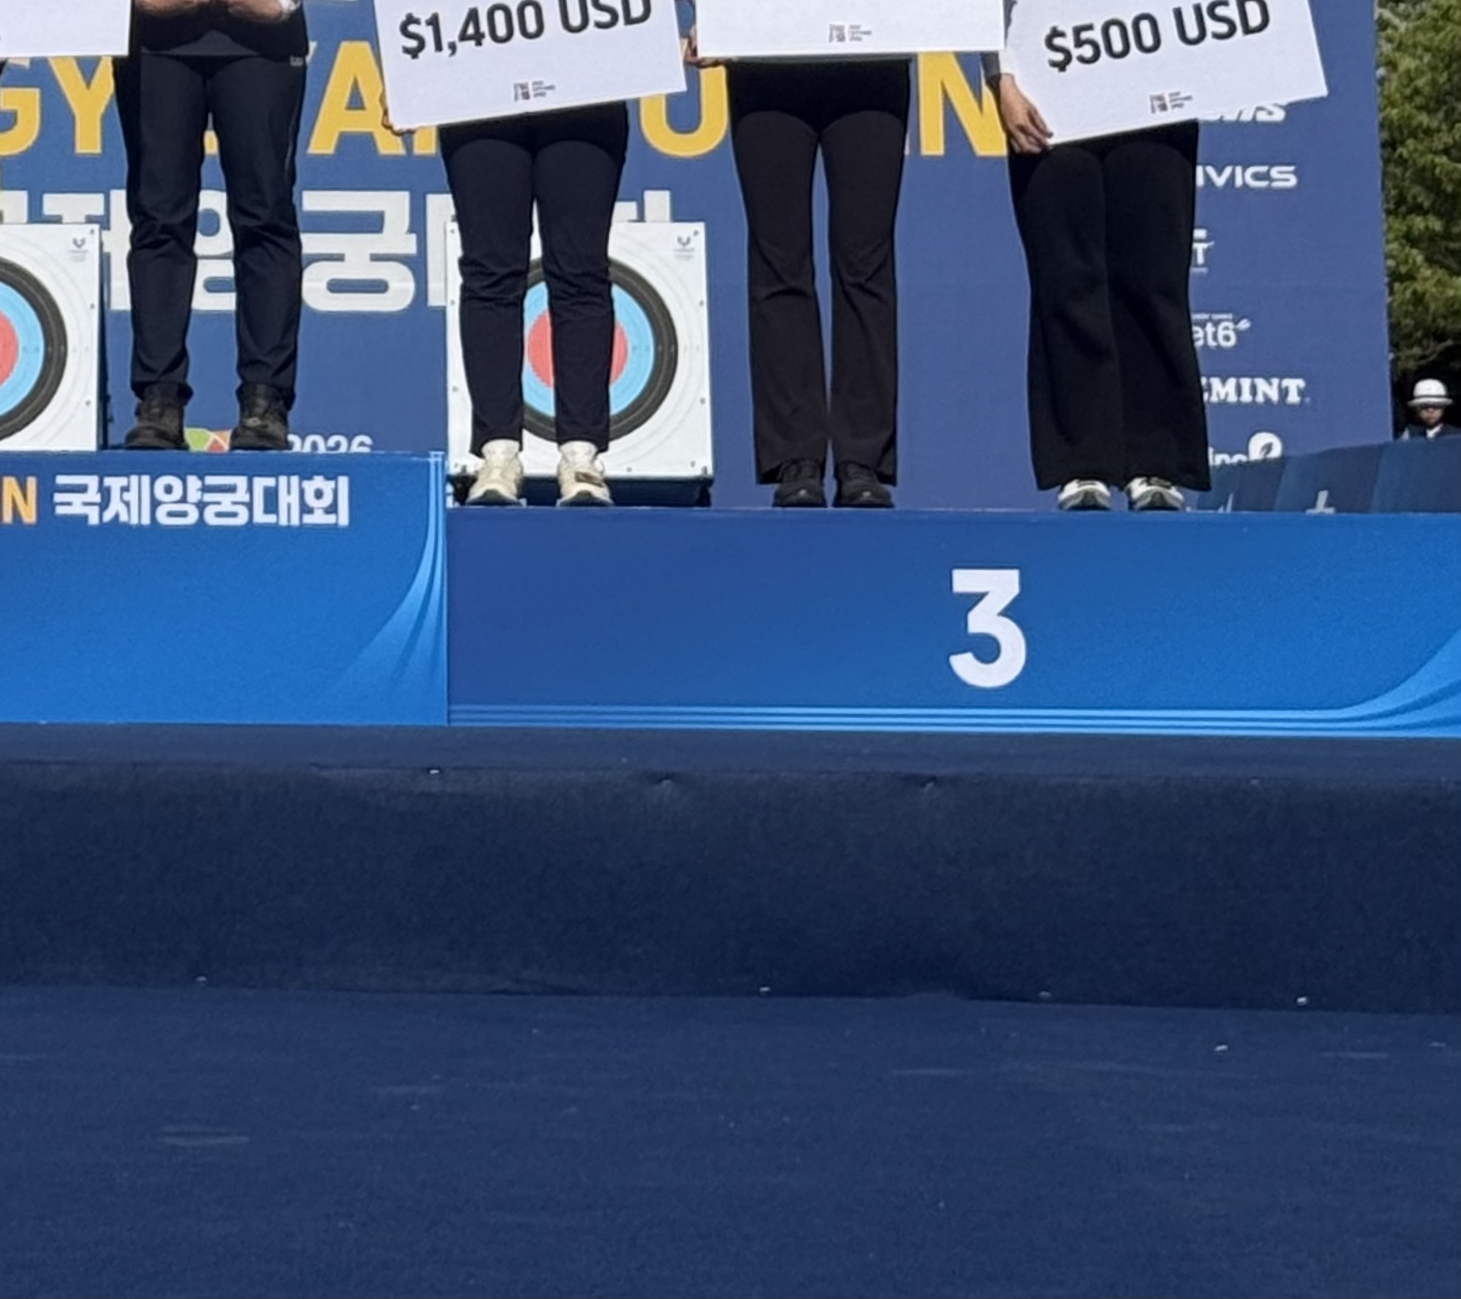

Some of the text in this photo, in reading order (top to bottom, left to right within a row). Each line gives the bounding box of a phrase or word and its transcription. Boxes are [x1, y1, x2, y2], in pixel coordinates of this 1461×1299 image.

[1044, 12, 1161, 72] $500
[1195, 165, 1298, 188] IVICS
[1192, 320, 1238, 349] et6
[52, 475, 350, 528] 국제양궁대회
[947, 569, 1027, 689] 3
